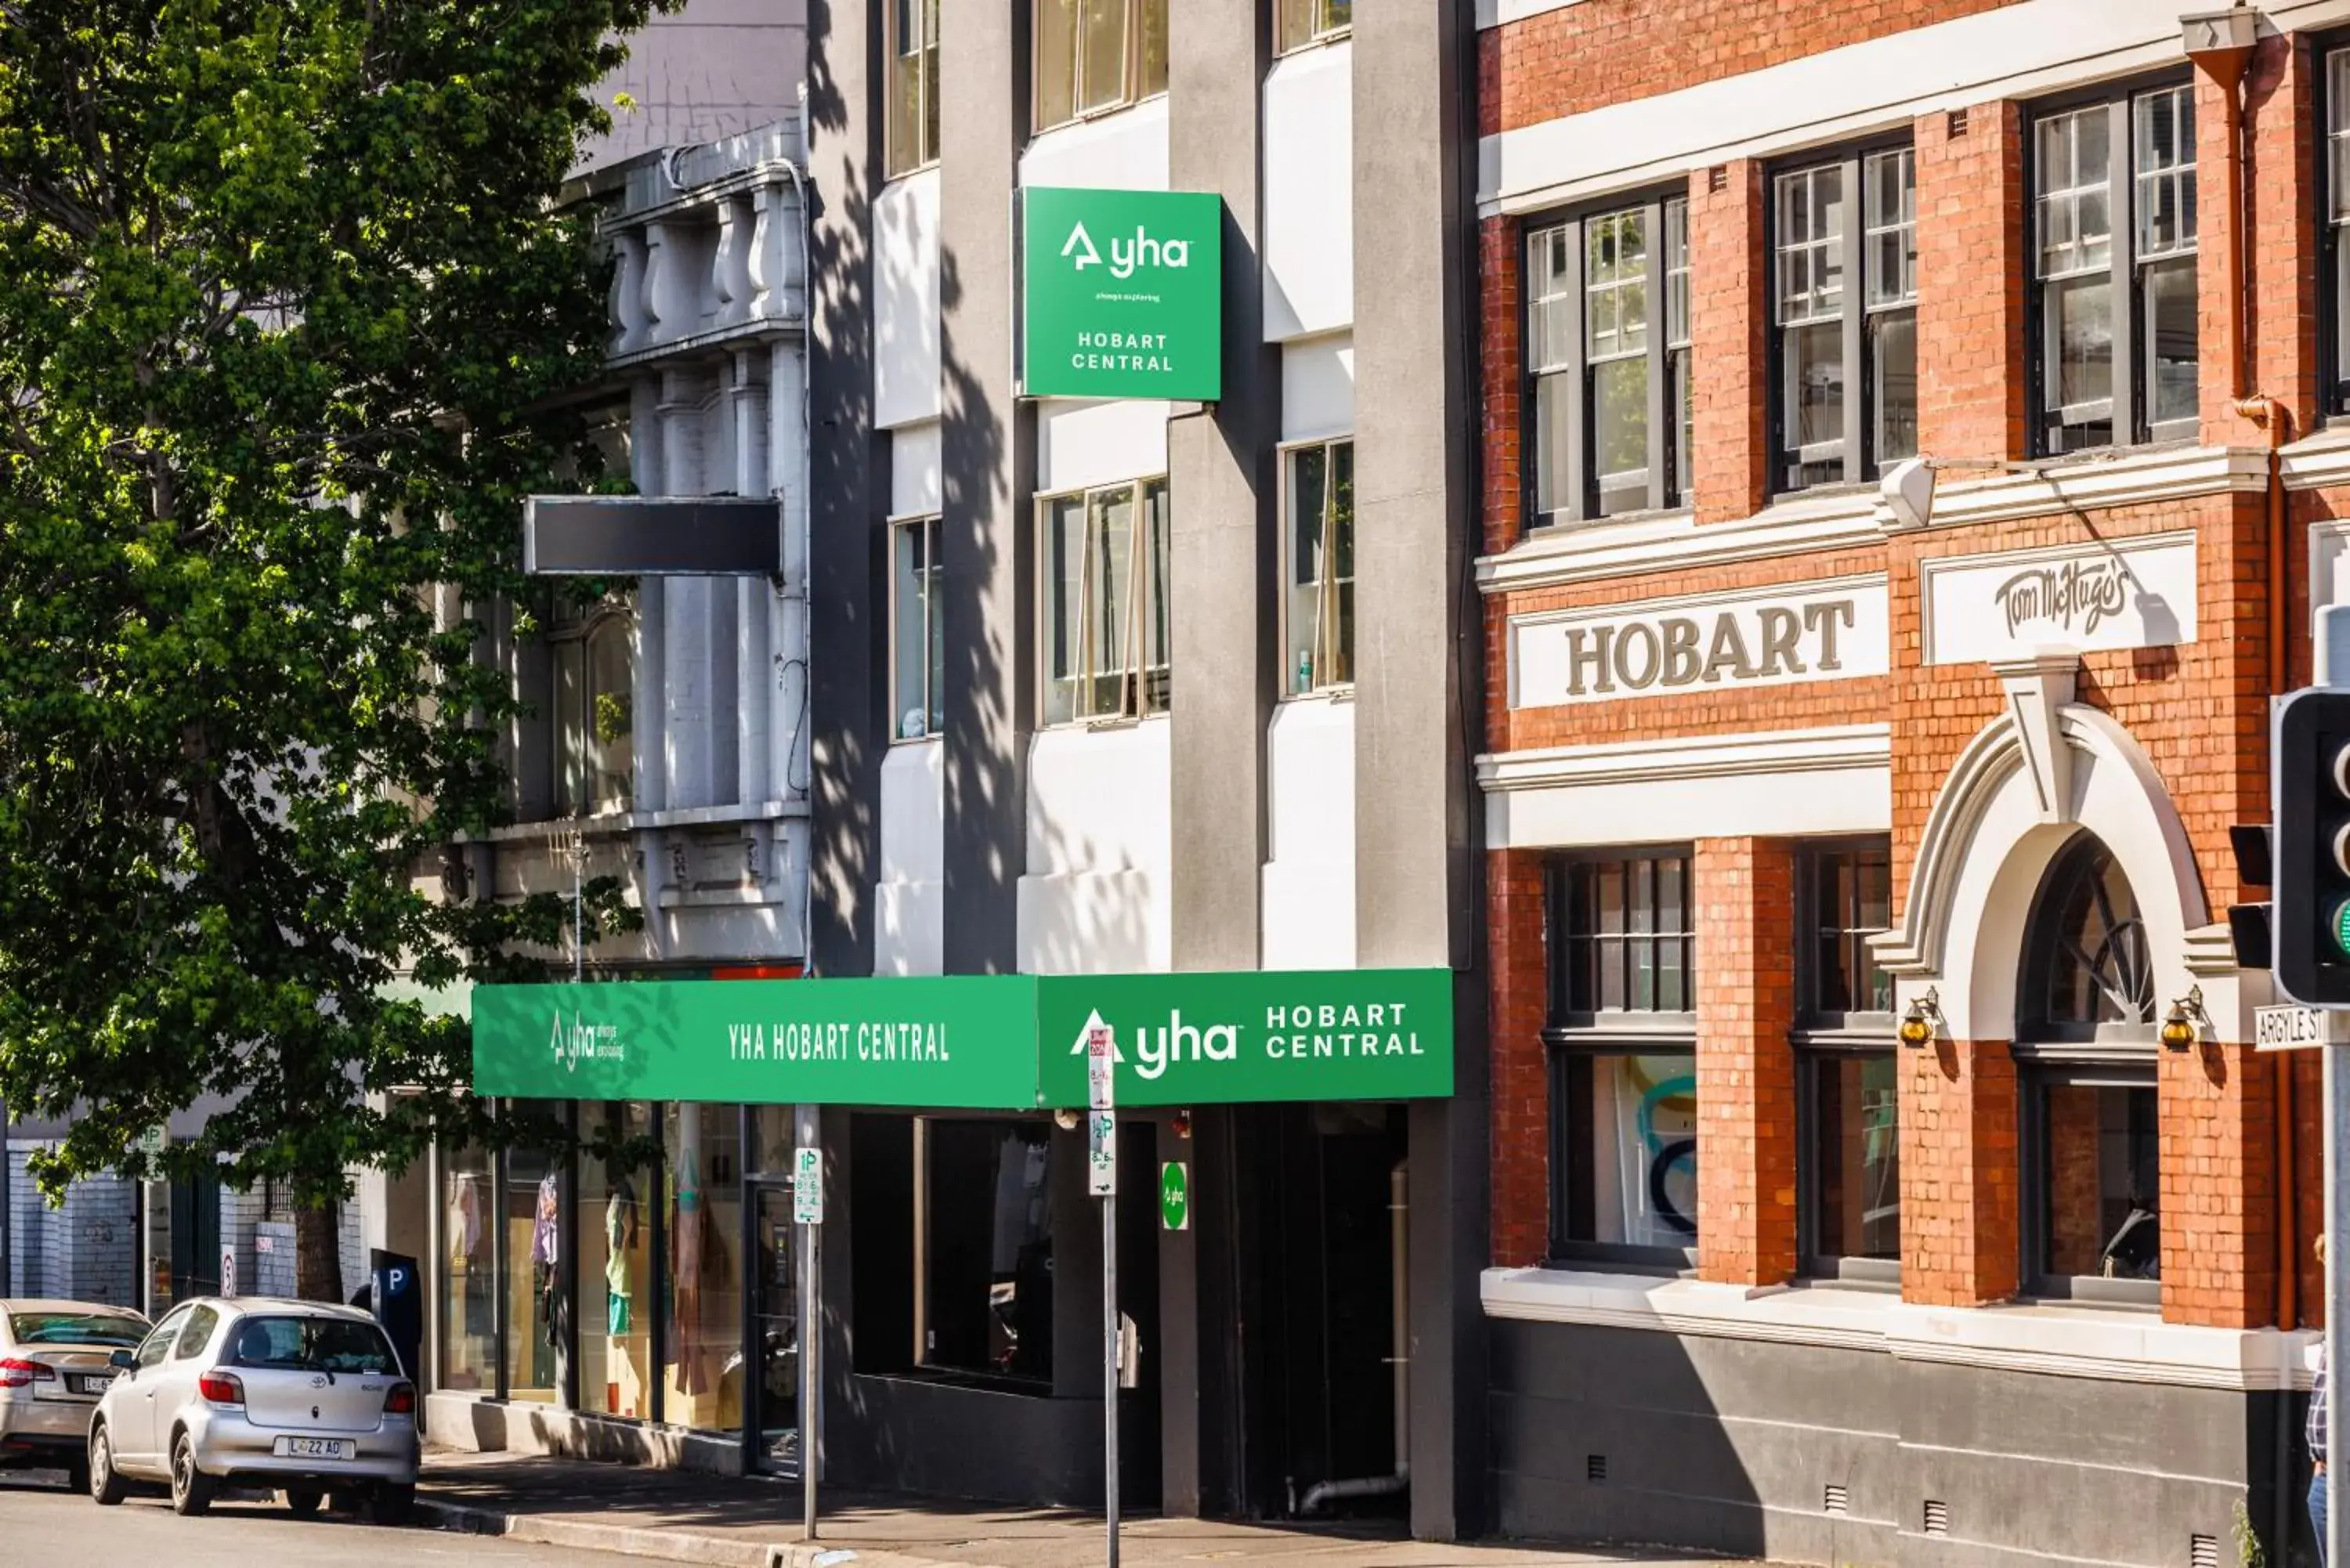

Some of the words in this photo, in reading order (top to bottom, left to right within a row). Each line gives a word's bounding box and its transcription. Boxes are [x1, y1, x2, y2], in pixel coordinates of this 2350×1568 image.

[1108, 224, 1189, 279] yha
[1078, 331, 1167, 350] HOBART
[1072, 353, 1173, 372] CENTRAL
[1994, 569, 2046, 640] Tom
[1564, 599, 1855, 695] HOBART
[1266, 1003, 1407, 1028] HOBART
[2259, 1010, 2305, 1044] ARGYLE
[2308, 1008, 2323, 1041] ST
[728, 1023, 765, 1060] YHA
[772, 1022, 850, 1060] HOBART
[858, 1022, 949, 1061] CENTRAL
[1133, 1008, 1238, 1080] yha
[1265, 1031, 1425, 1058] CENTRAL
[801, 1152, 817, 1172] 1P
[389, 1269, 403, 1291] P
